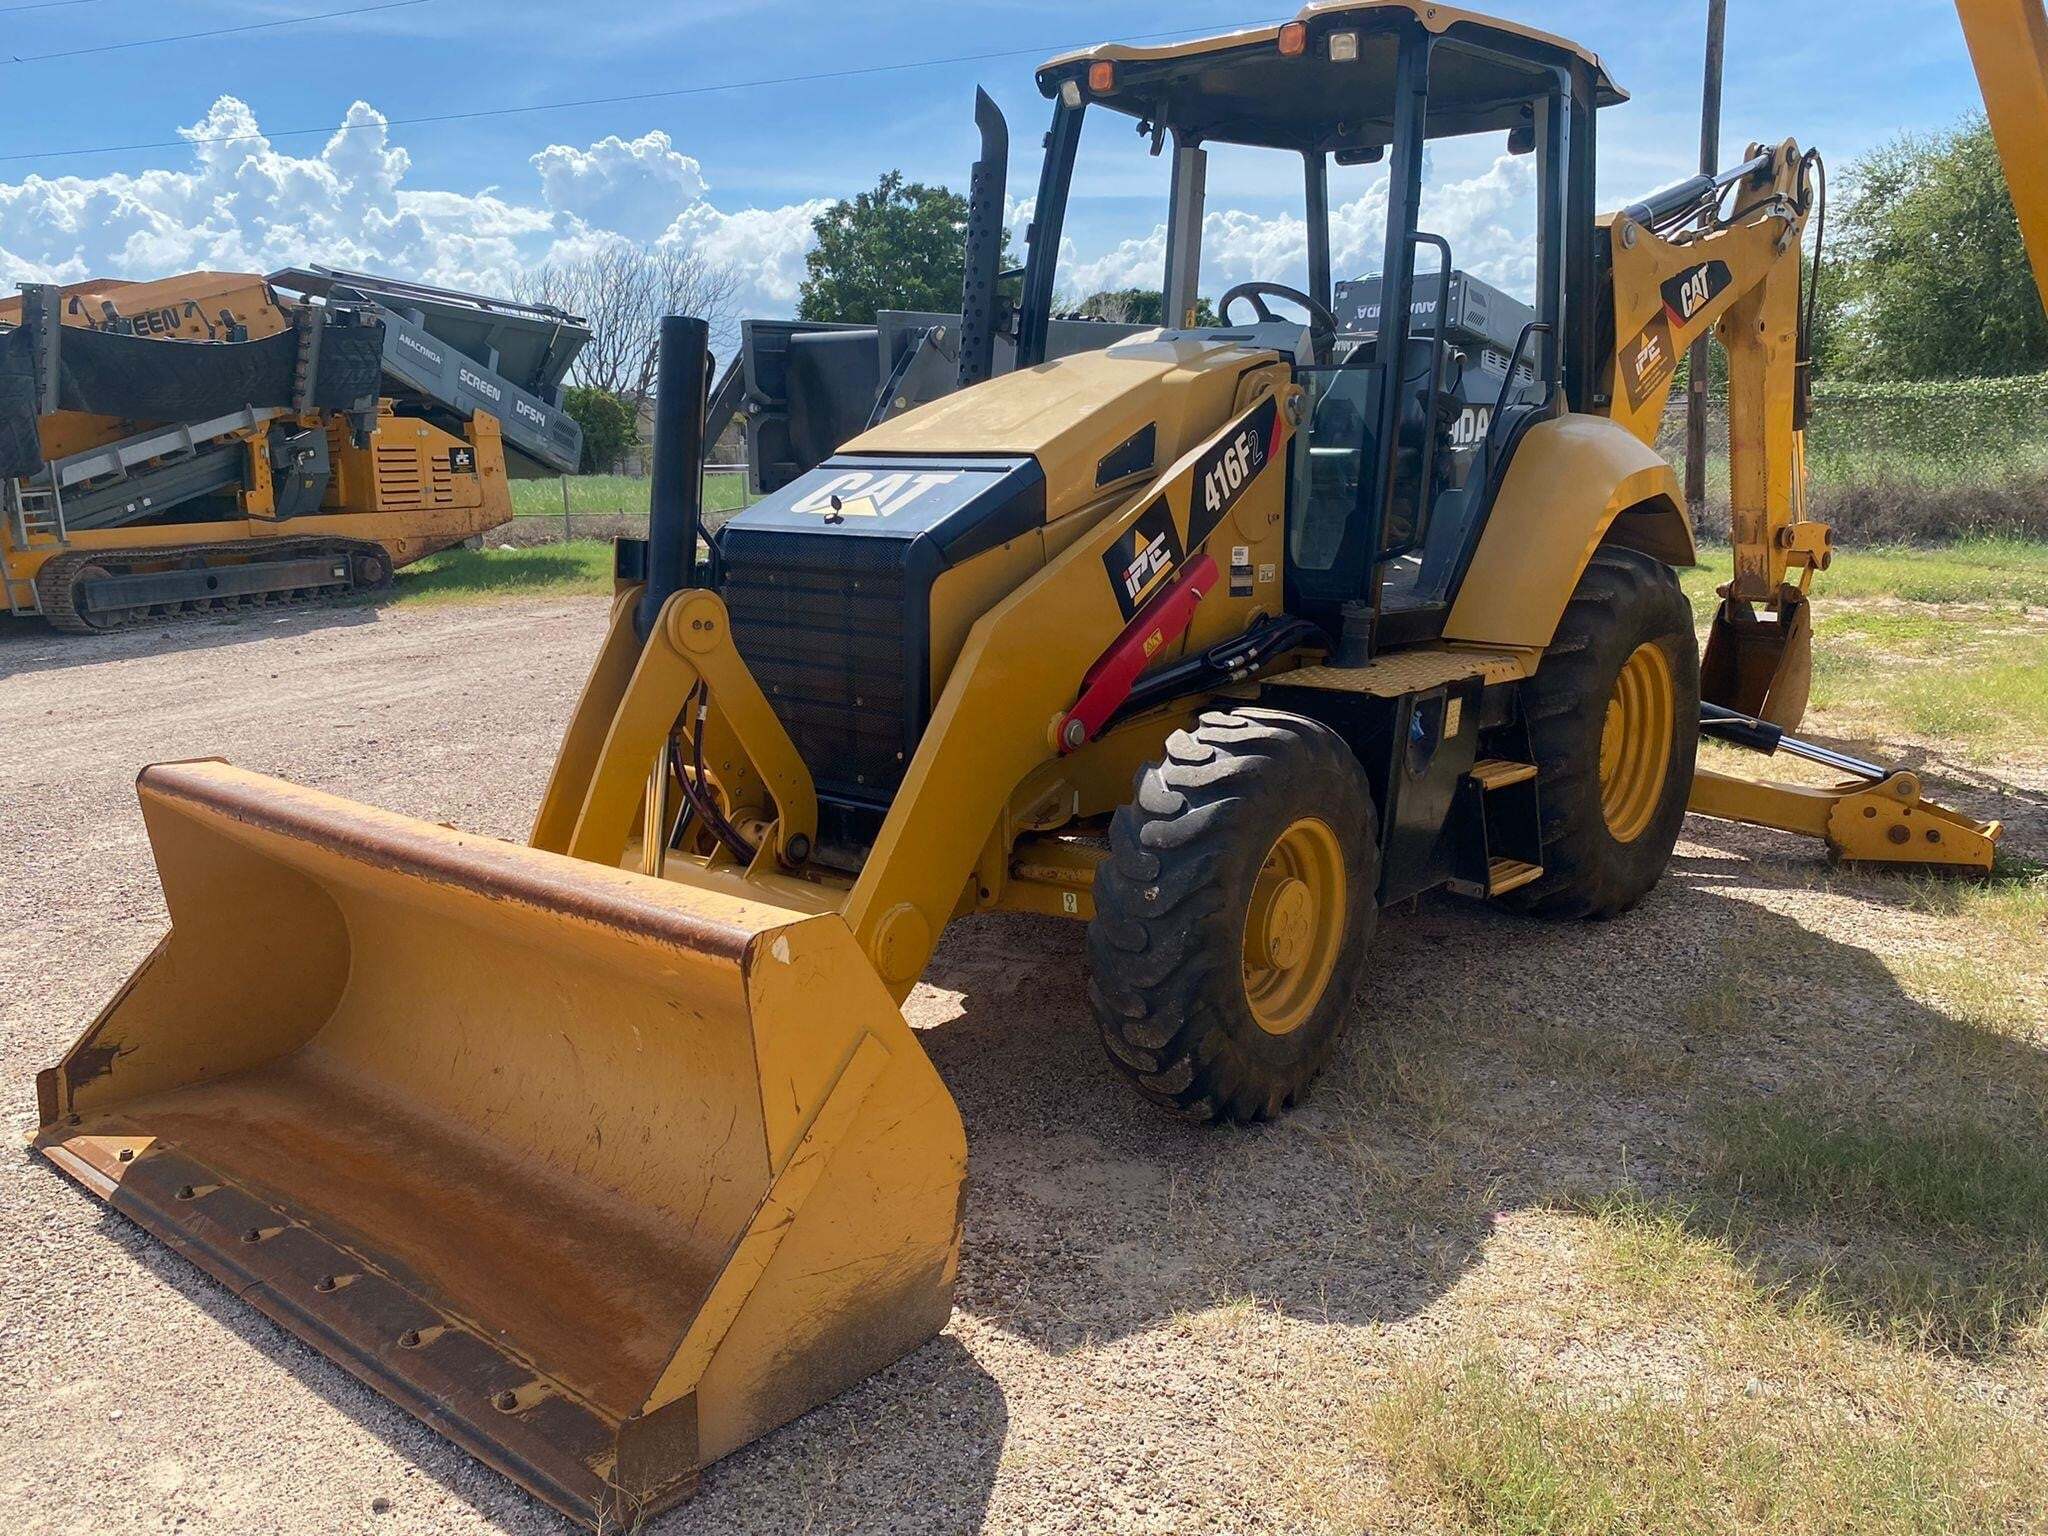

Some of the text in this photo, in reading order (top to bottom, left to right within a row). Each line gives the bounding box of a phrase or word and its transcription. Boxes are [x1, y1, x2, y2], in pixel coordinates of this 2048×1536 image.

[1680, 262, 1709, 318] CAT
[132, 307, 182, 337] EEN
[399, 334, 441, 364] ANACONDA
[459, 368, 501, 402] SCREEN
[790, 472, 957, 517] CAT
